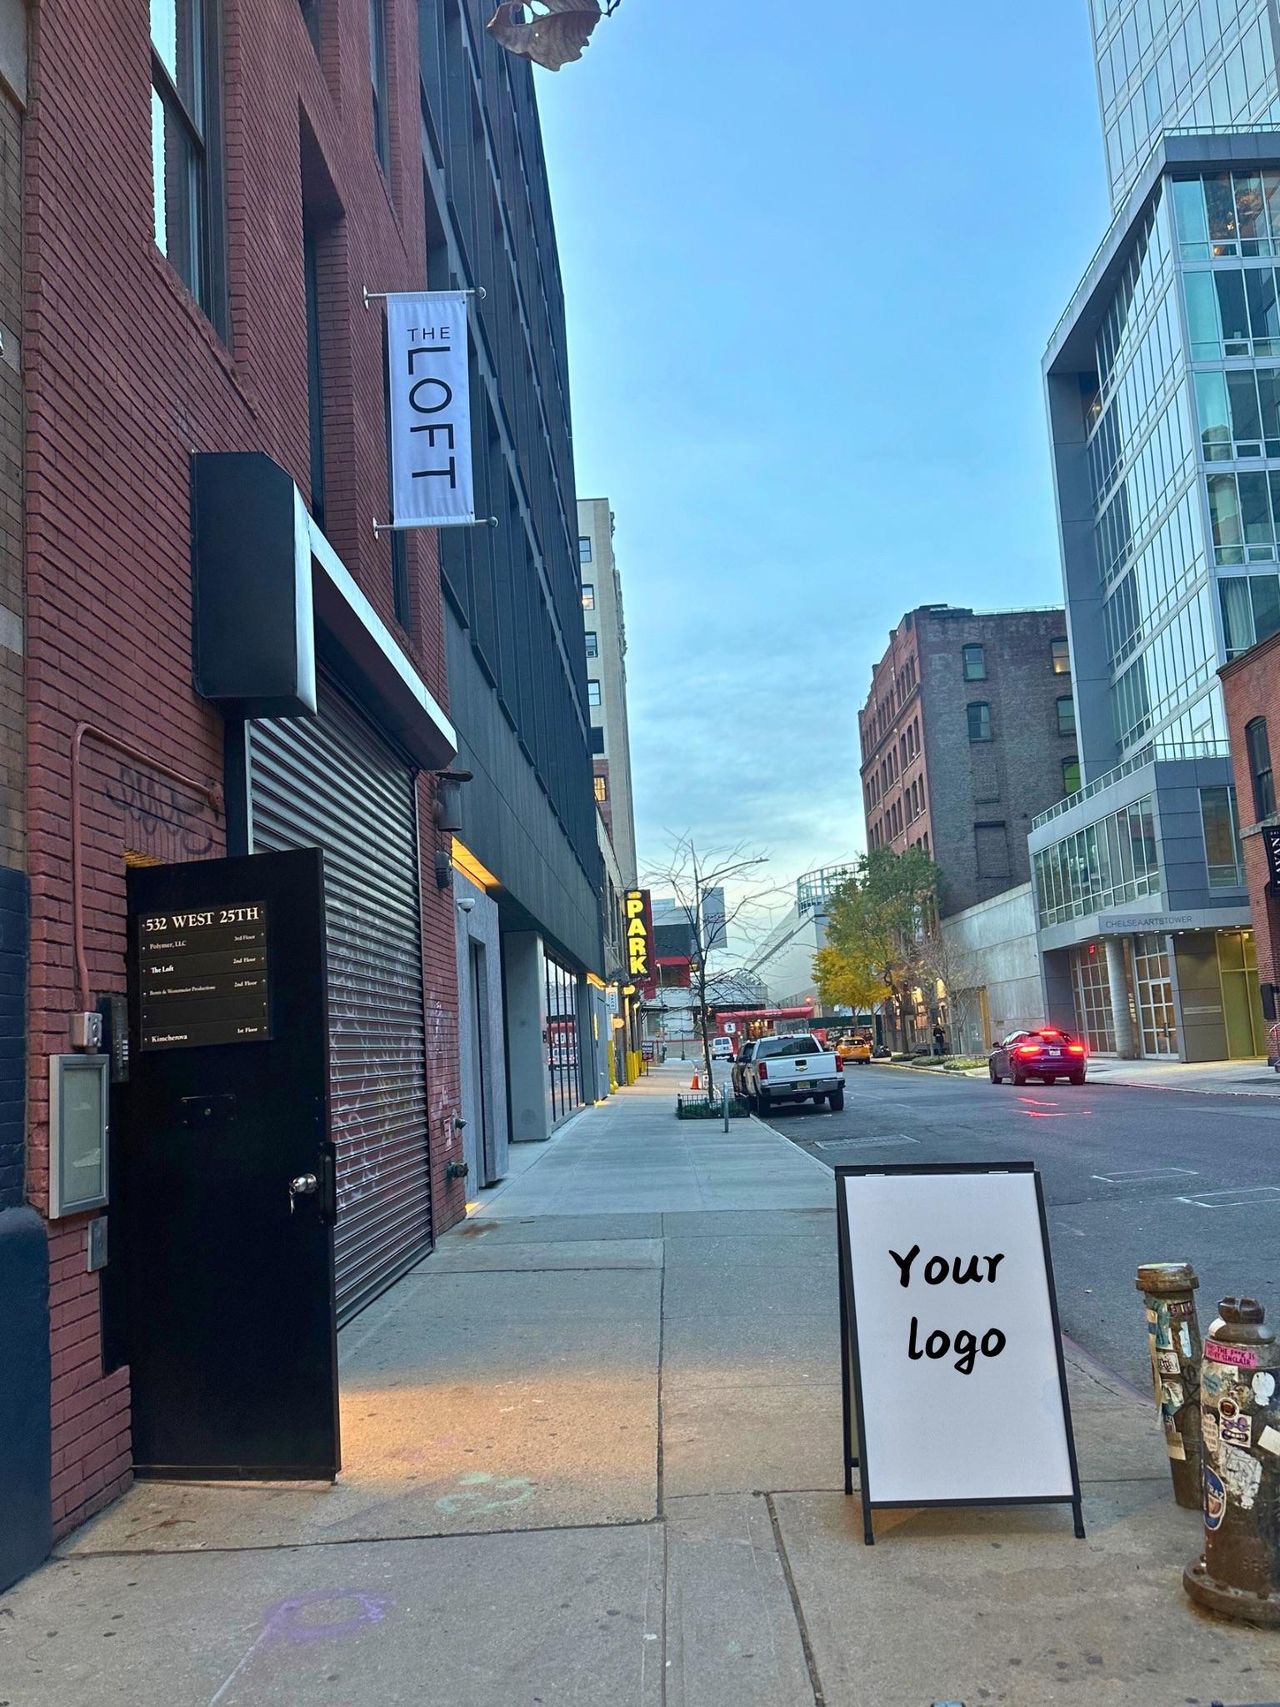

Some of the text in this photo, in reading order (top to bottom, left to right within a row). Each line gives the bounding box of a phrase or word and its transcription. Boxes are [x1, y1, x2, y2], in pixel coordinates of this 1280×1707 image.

[407, 326, 450, 342] THE
[407, 346, 456, 489] LOFT
[146, 907, 259, 931] 532 WEST 25TH
[626, 900, 647, 974] PARK
[151, 965, 174, 974] The Loft
[888, 1244, 1005, 1288] Your
[907, 1316, 1007, 1376] logo
